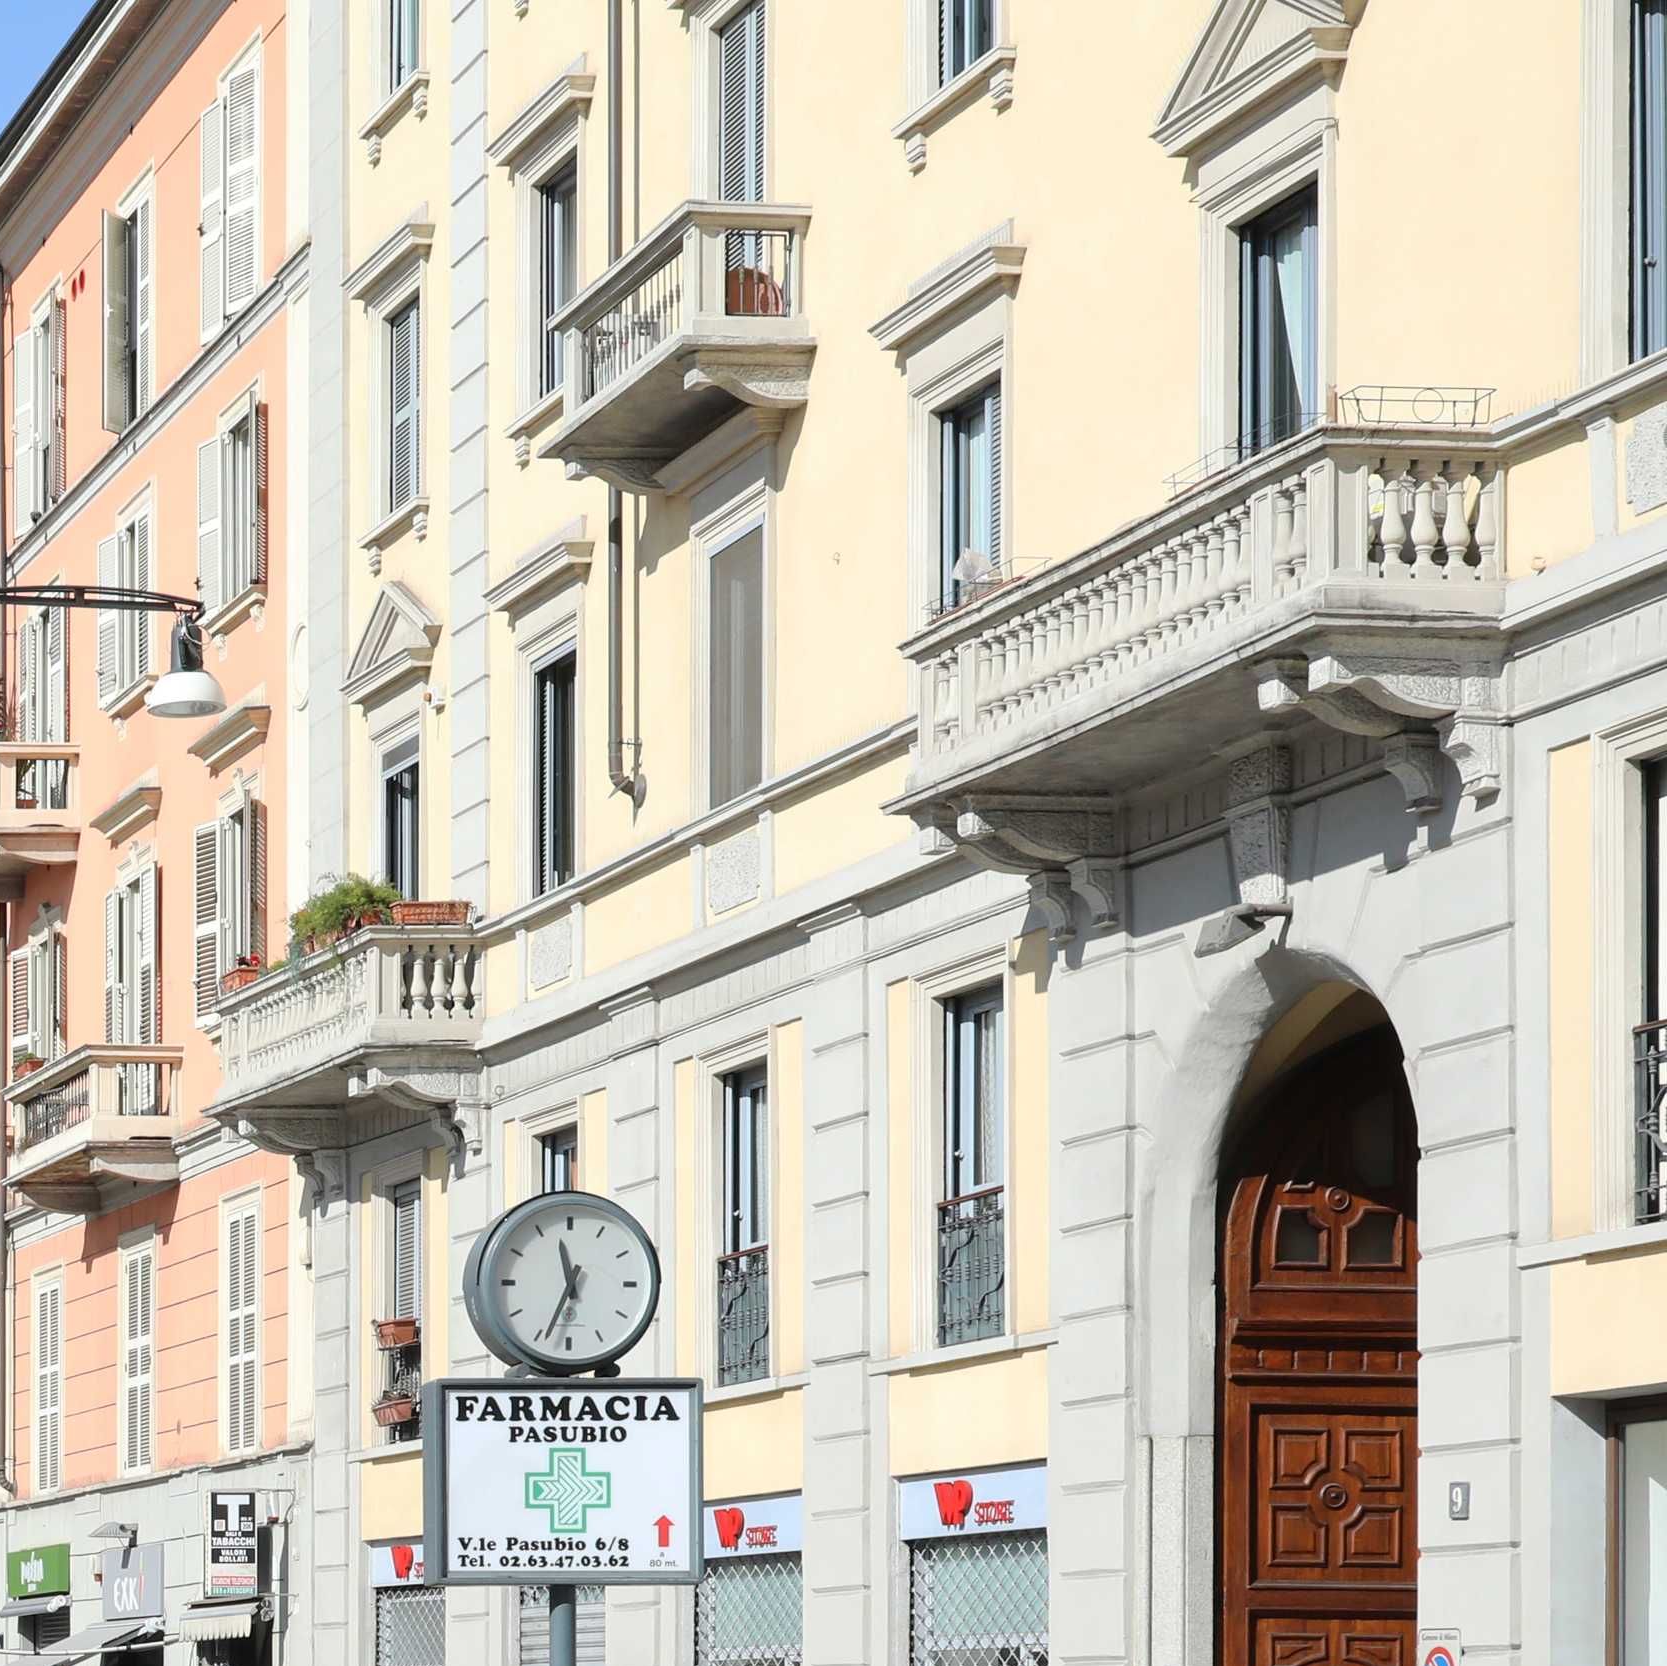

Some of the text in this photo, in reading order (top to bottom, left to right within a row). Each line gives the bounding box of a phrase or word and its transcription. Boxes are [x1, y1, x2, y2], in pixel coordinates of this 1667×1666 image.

[455, 1396, 680, 1421] FARMACIA
[508, 1426, 627, 1443] PASUBIO
[1452, 1487, 1463, 1513] 9
[216, 1494, 250, 1531] T
[974, 1500, 1015, 1525] STORE
[211, 1537, 255, 1546] TABACCHI
[457, 1537, 629, 1551] V.le Pasubio 6/8
[745, 1525, 778, 1549] STORE
[457, 1555, 629, 1568] Tel. 02.63.47.03.62
[649, 1559, 679, 1567] 80 mt.
